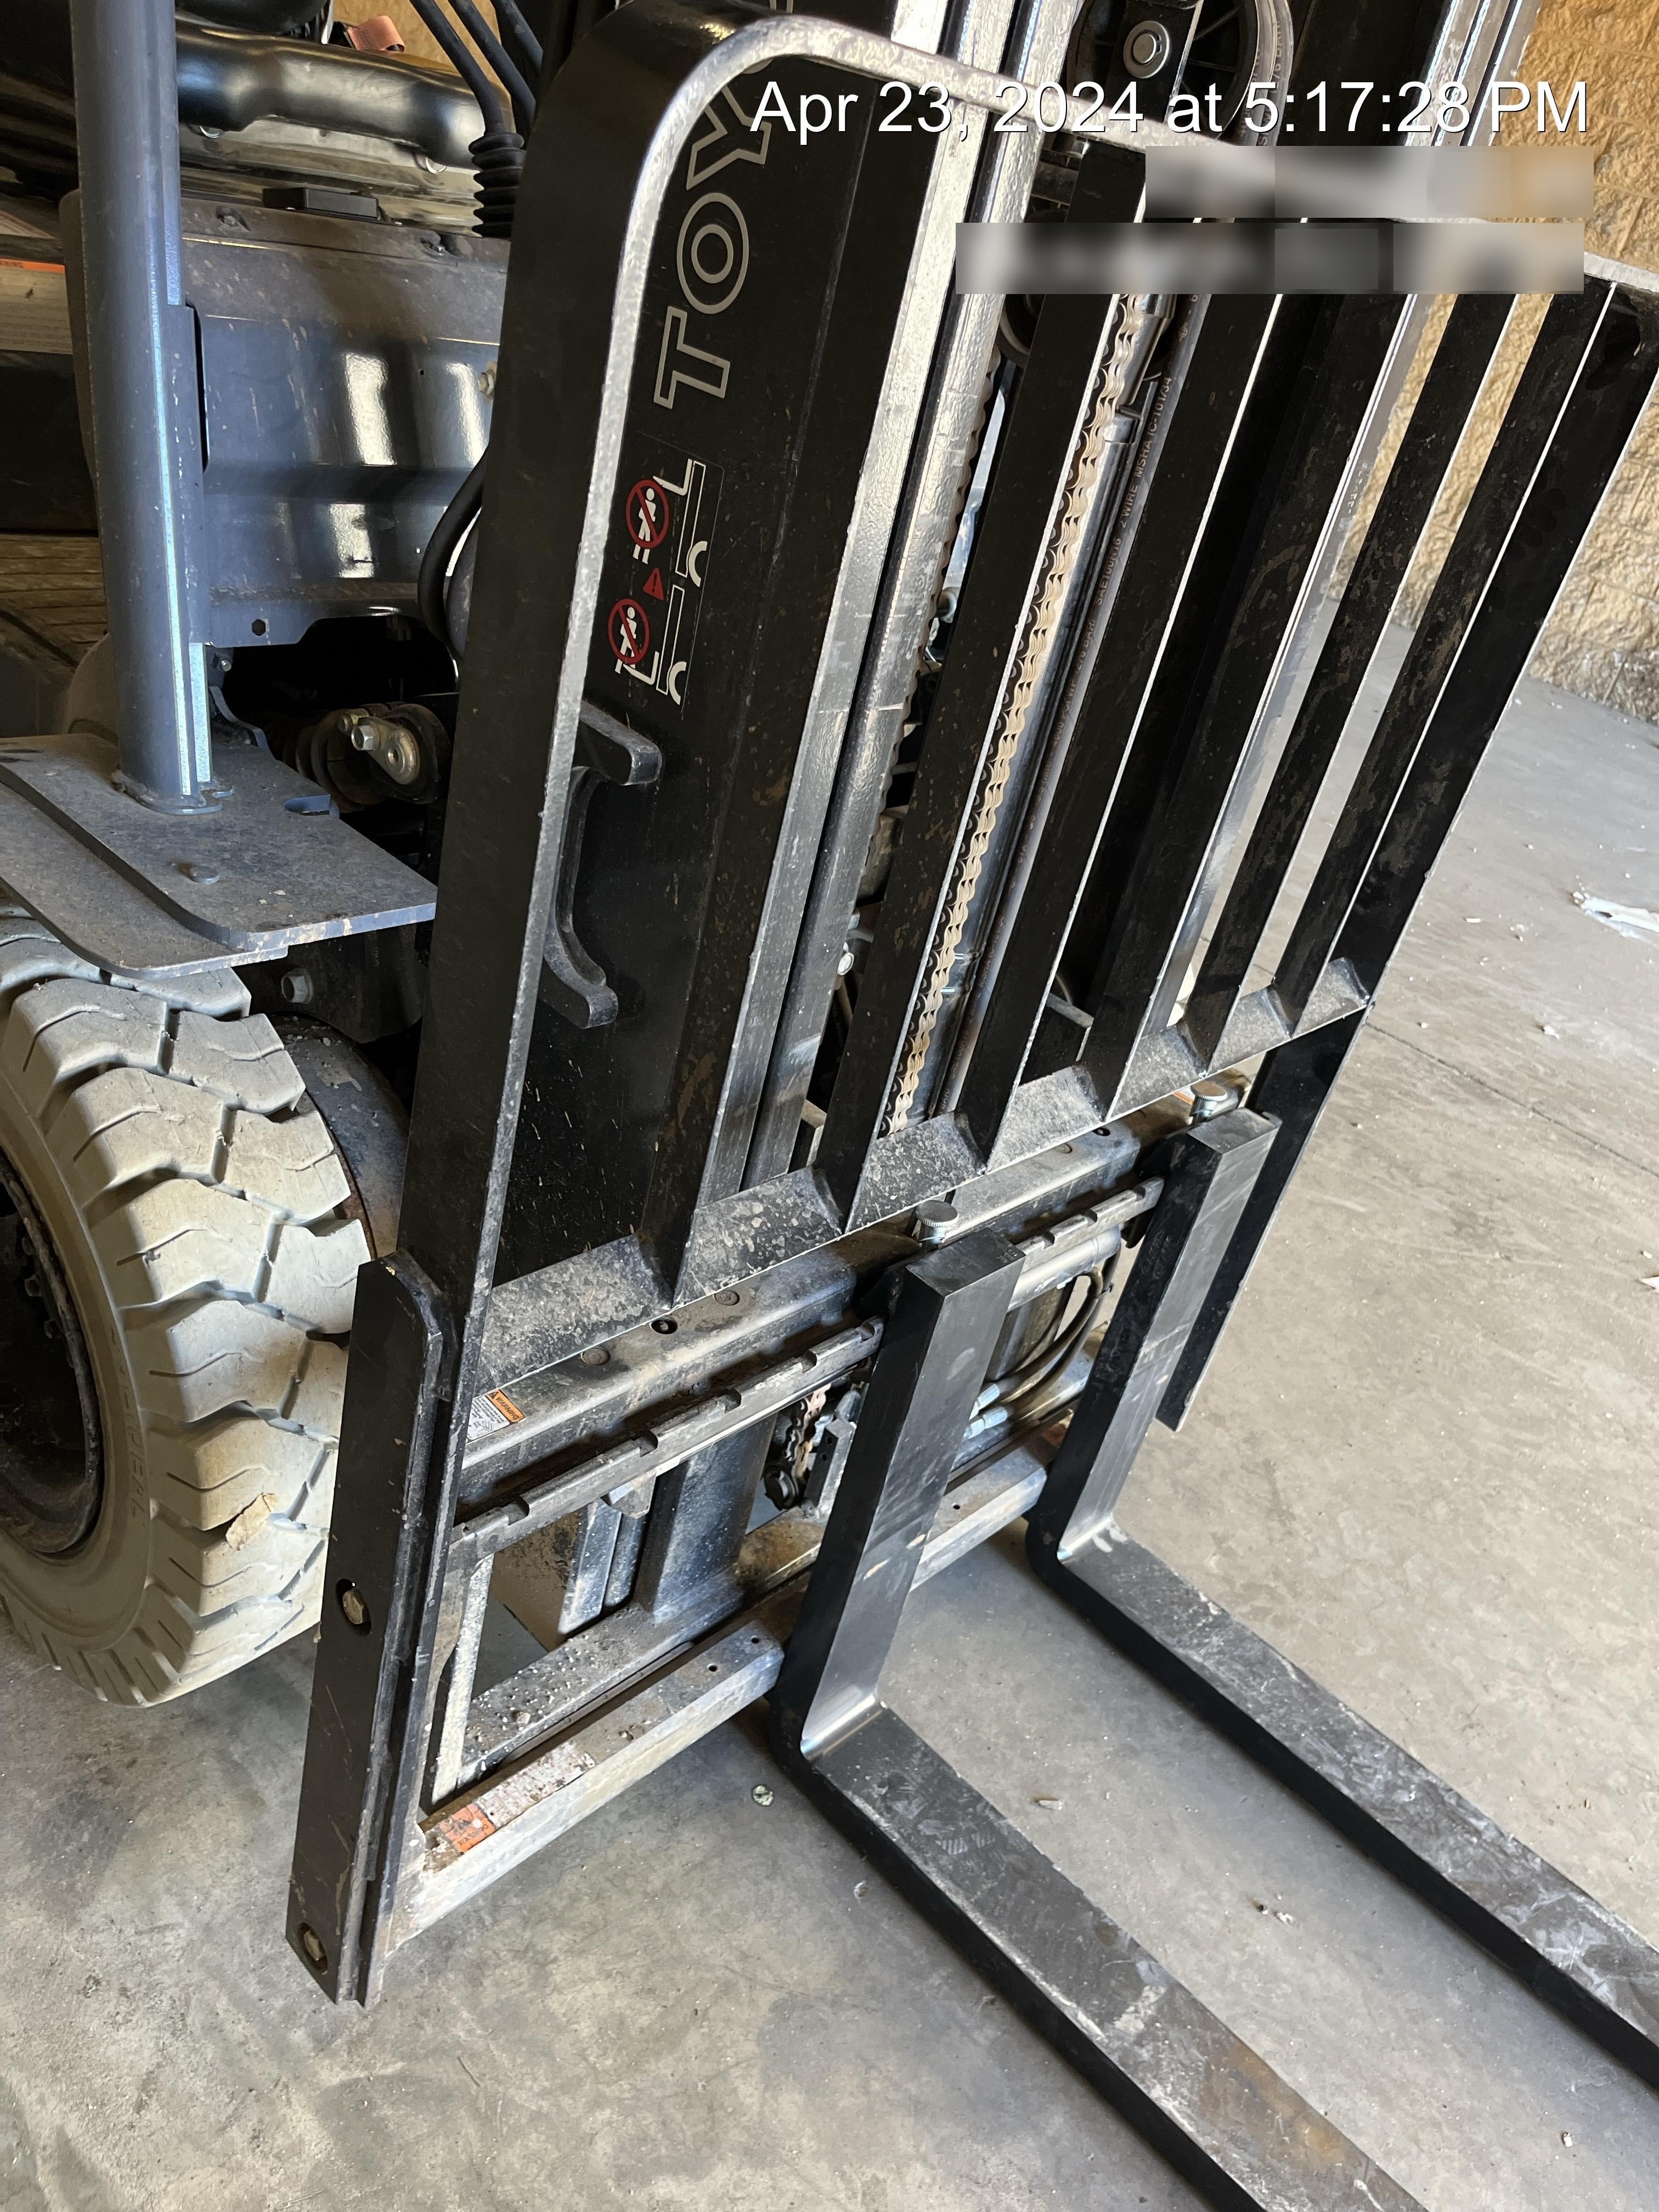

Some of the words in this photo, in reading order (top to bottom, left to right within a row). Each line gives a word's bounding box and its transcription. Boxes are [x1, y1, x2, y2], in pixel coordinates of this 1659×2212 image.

[653, 0, 794, 409] TOY
[1122, 484, 1138, 517] WIRE
[1135, 440, 1152, 478] MSHA
[1148, 376, 1173, 436] IC-101/34
[495, 1396, 520, 1420] WARNING
